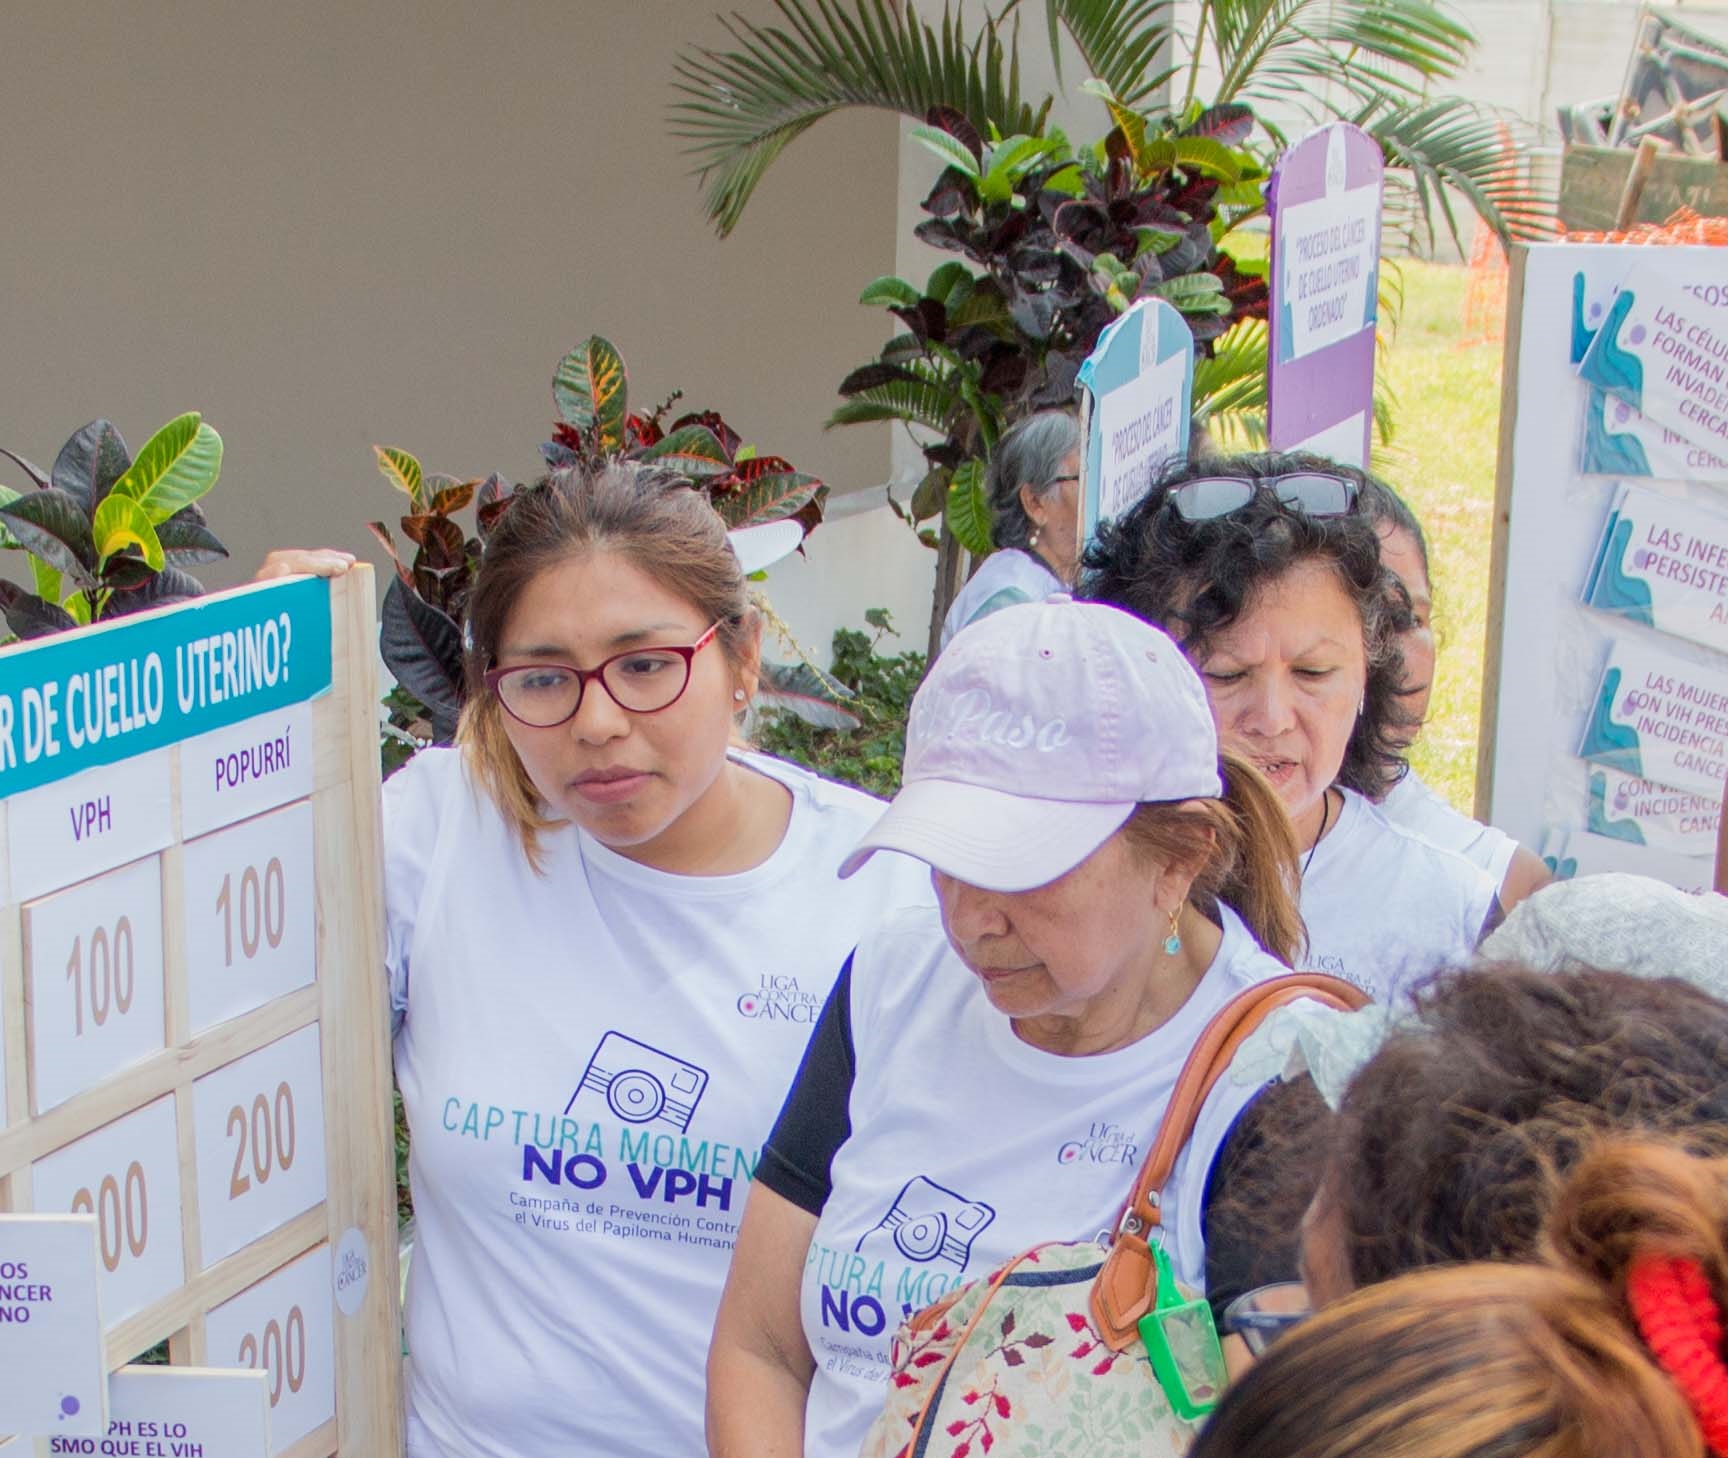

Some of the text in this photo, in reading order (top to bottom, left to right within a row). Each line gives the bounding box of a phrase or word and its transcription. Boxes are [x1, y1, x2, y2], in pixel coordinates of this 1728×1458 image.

[1329, 226, 1342, 252] DEL
[1298, 255, 1361, 300] DE CUELLO UTERINO
[1653, 305, 1685, 334] LAS
[1652, 331, 1725, 383] FORMAN
[1647, 524, 1683, 553] LAS
[20, 681, 61, 764] DE
[65, 651, 164, 751] CUELLO
[175, 612, 292, 715] UTERINO?
[1646, 671, 1676, 694] LAS
[1627, 688, 1662, 713] CON
[1665, 702, 1694, 724] VIH
[1636, 714, 1725, 758] INCIDENCIA
[214, 724, 292, 793] POPURRÍ
[69, 795, 112, 842] VPH
[215, 856, 286, 968] 100
[66, 915, 135, 1038] 100
[759, 989, 818, 1005] CONTRA
[760, 973, 800, 991] LIGA
[225, 1081, 296, 1201] 200
[442, 1096, 603, 1158] CAPTURA
[522, 1143, 734, 1212] NO VPH
[510, 1190, 580, 1215] Campaña
[585, 1201, 604, 1216] de
[610, 1204, 691, 1229] Prevención
[515, 1210, 526, 1225] el
[531, 1214, 571, 1232] Virus
[576, 1217, 597, 1233] del
[603, 1219, 673, 1242] Papiloma
[821, 1283, 887, 1337] NO
[100, 1439, 141, 1458] QUE
[145, 1441, 167, 1458] EL
[170, 1442, 204, 1458] VIH
[137, 1421, 159, 1438] ES
[163, 1422, 188, 1439] LO
